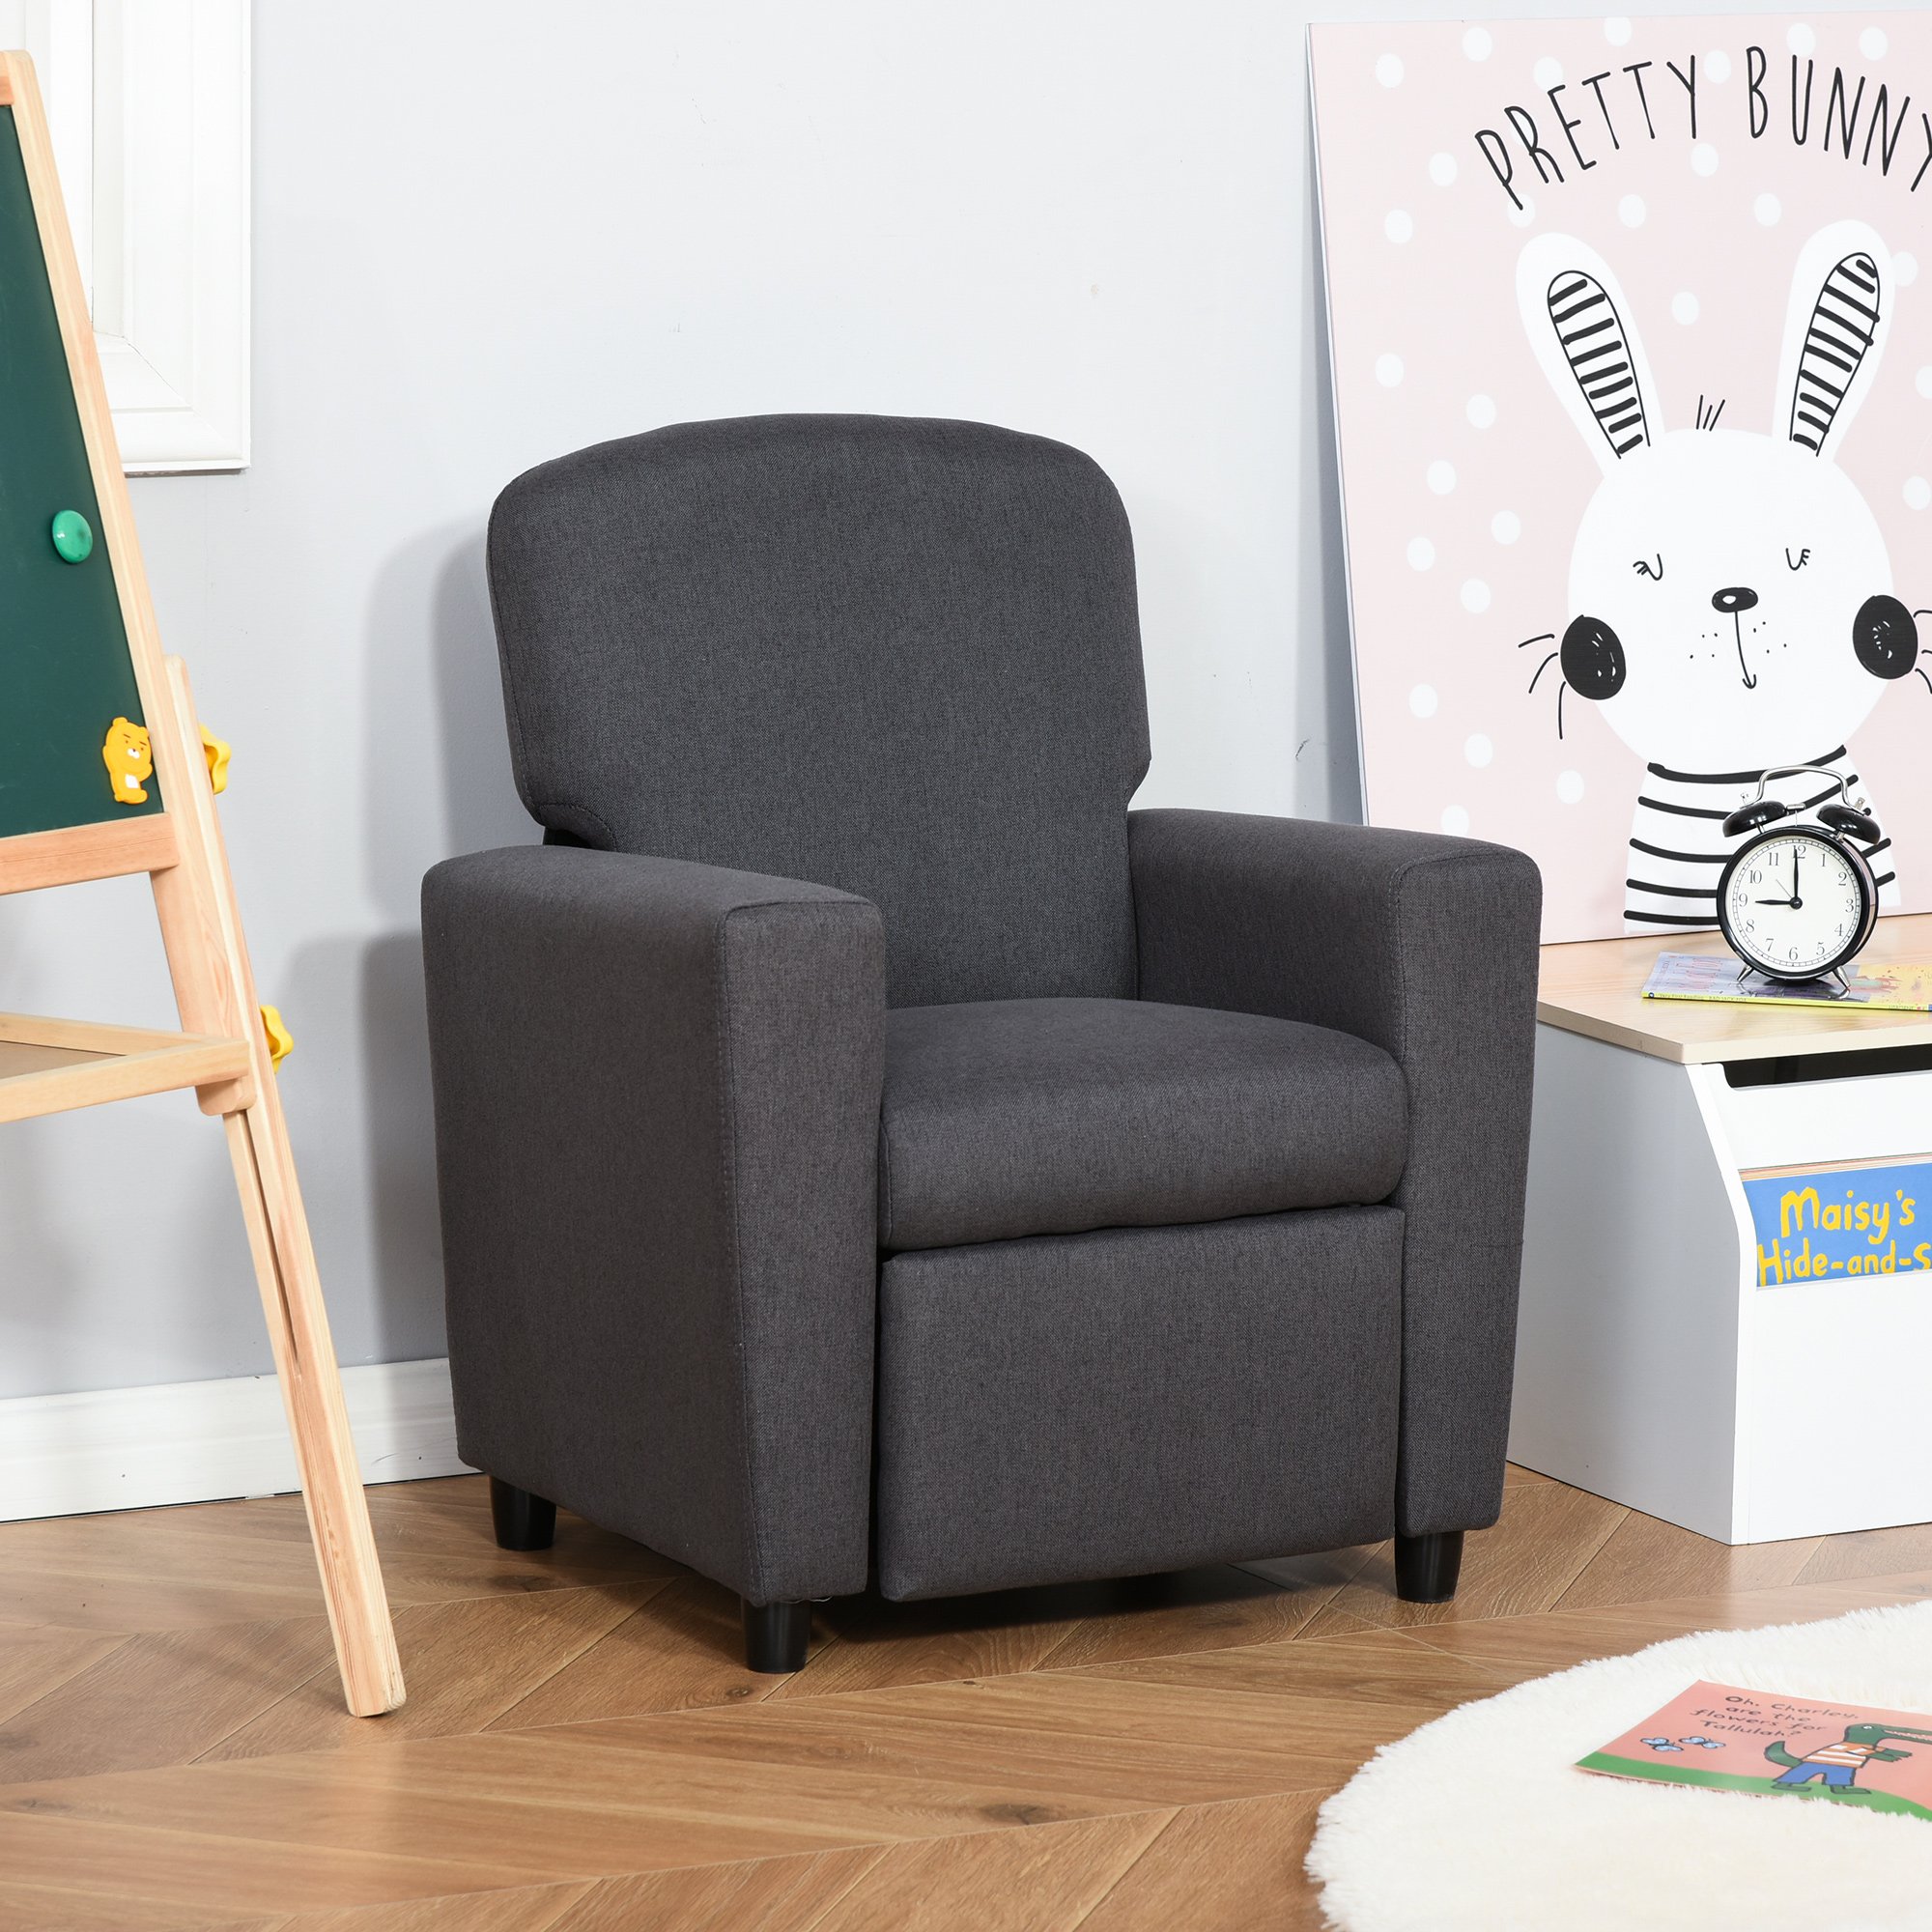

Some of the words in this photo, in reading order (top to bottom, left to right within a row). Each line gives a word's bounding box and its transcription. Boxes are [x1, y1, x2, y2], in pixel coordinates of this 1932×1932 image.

[1475, 54, 1696, 211] PRETTY
[1746, 46, 1932, 192] BUNNY
[1768, 852, 1779, 867] 11
[1792, 844, 1806, 860] 12
[1820, 853, 1827, 867] 1
[1749, 869, 1763, 884] 10
[1837, 872, 1847, 887] 2
[1739, 893, 1748, 907] 9
[1845, 898, 1855, 913] 3
[1746, 919, 1755, 934] 8
[1834, 923, 1843, 937] 4
[1765, 938, 1775, 952] 7
[1816, 942, 1826, 956] 5
[1788, 947, 1799, 960] 6
[1780, 1186, 1916, 1244] Maisy's
[1690, 1708, 1779, 1727] flowers
[1788, 1722, 1828, 1731] for
[1725, 1707, 1761, 1716] are
[1773, 1713, 1811, 1722] the
[1700, 1719, 1802, 1738] Tallulah?
